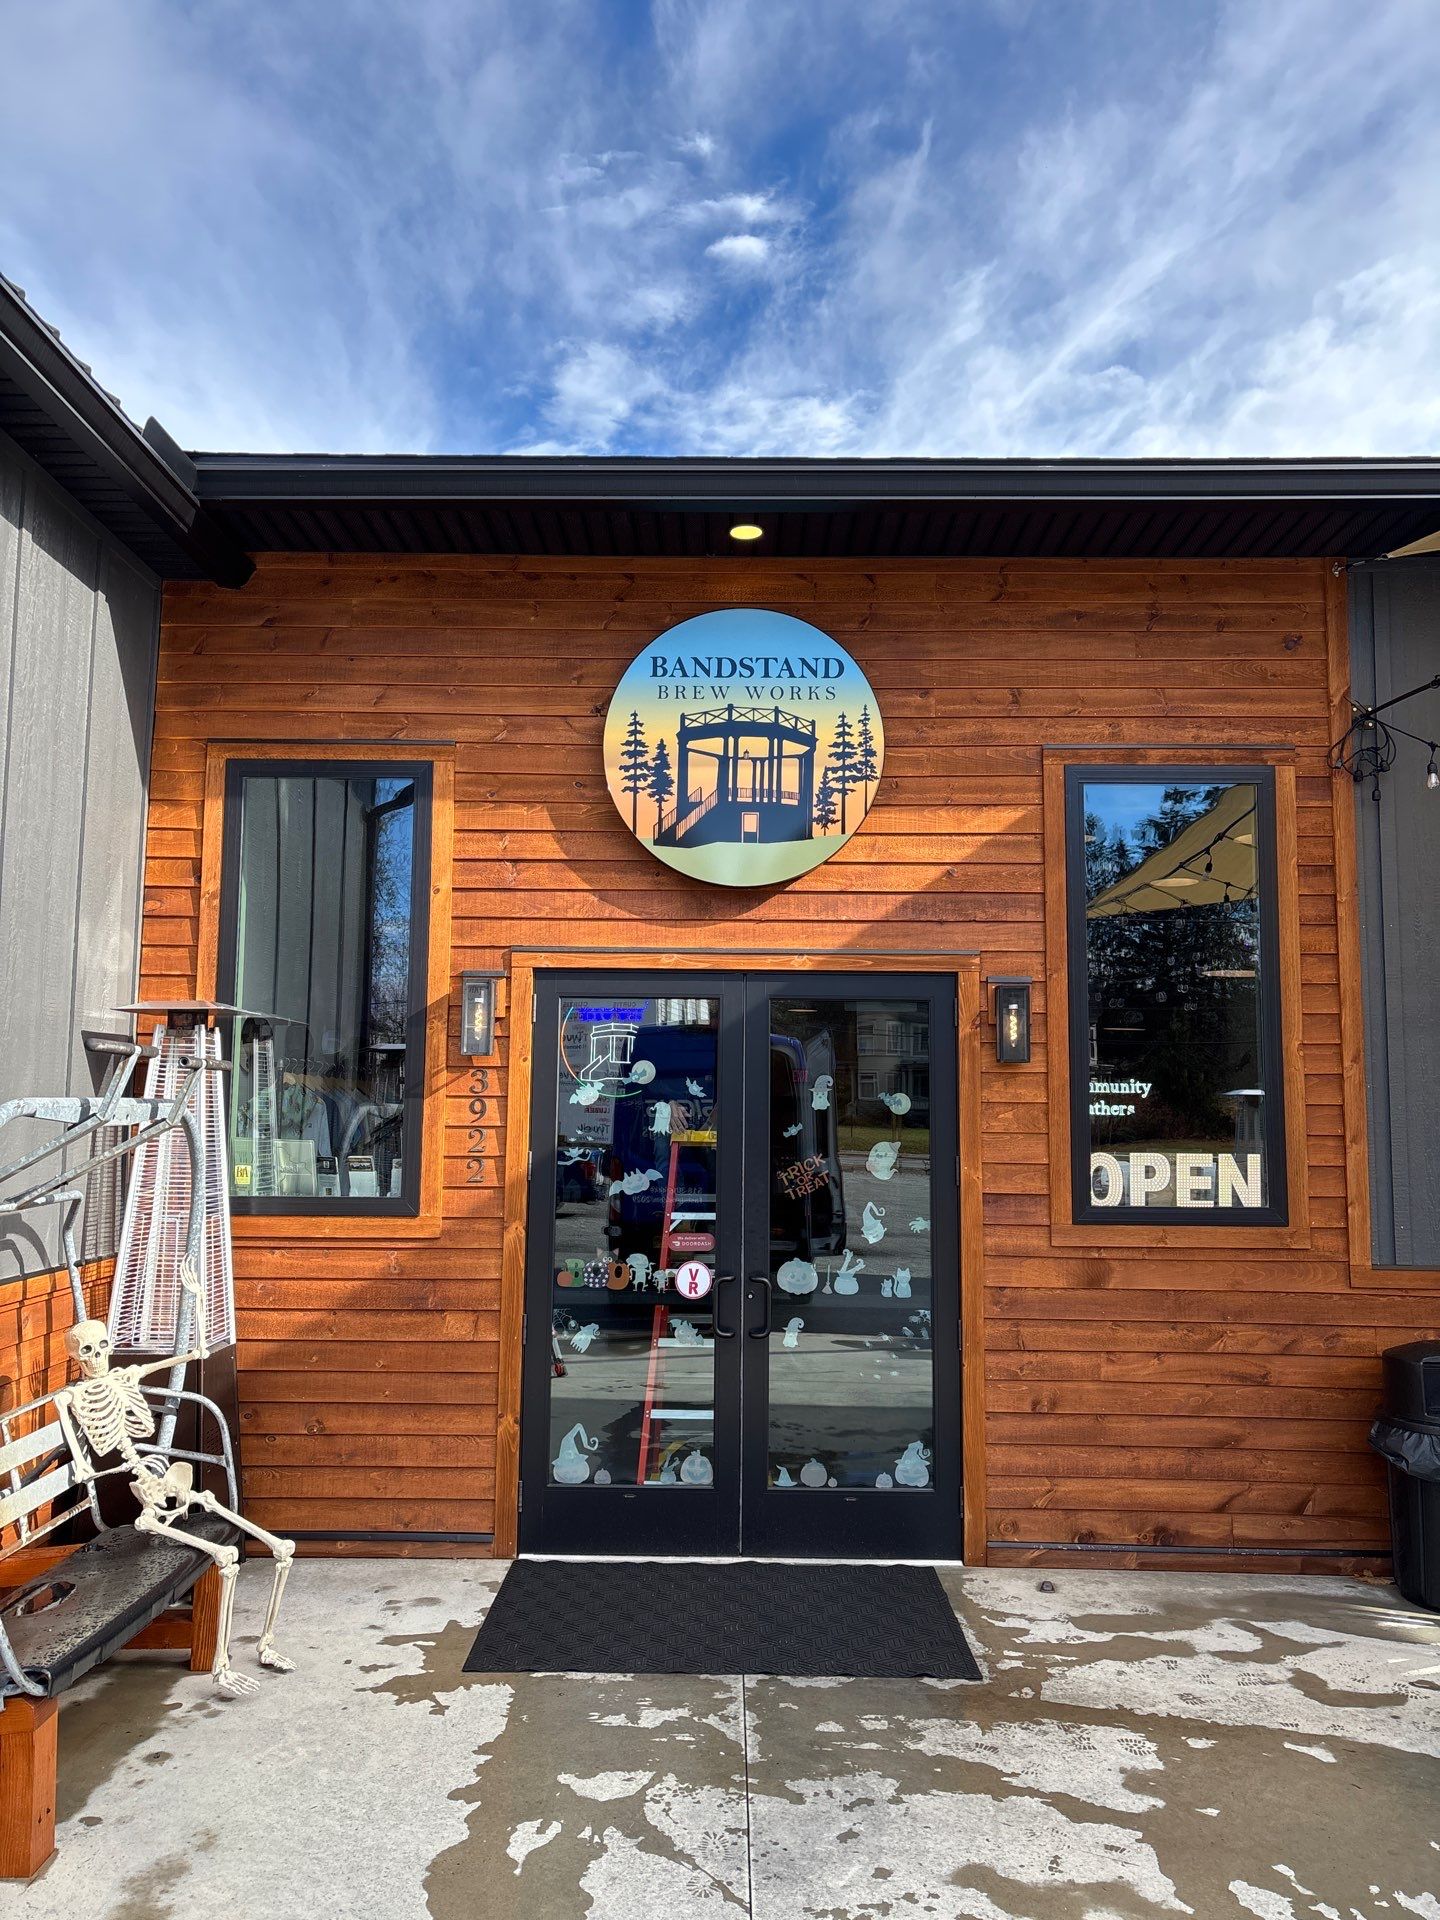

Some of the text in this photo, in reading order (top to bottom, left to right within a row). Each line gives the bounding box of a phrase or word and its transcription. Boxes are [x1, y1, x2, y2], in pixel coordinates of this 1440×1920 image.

[650, 656, 845, 679] BANDSTAND
[657, 685, 837, 700] BREW WORKS
[1089, 1078, 1152, 1098] munity
[465, 1068, 489, 1184] 3922
[780, 1153, 826, 1186] TRICK
[784, 1169, 830, 1200] TREAT
[796, 1172, 814, 1186] OR
[1090, 1152, 1262, 1208] OPEN
[564, 1258, 630, 1291] BOO
